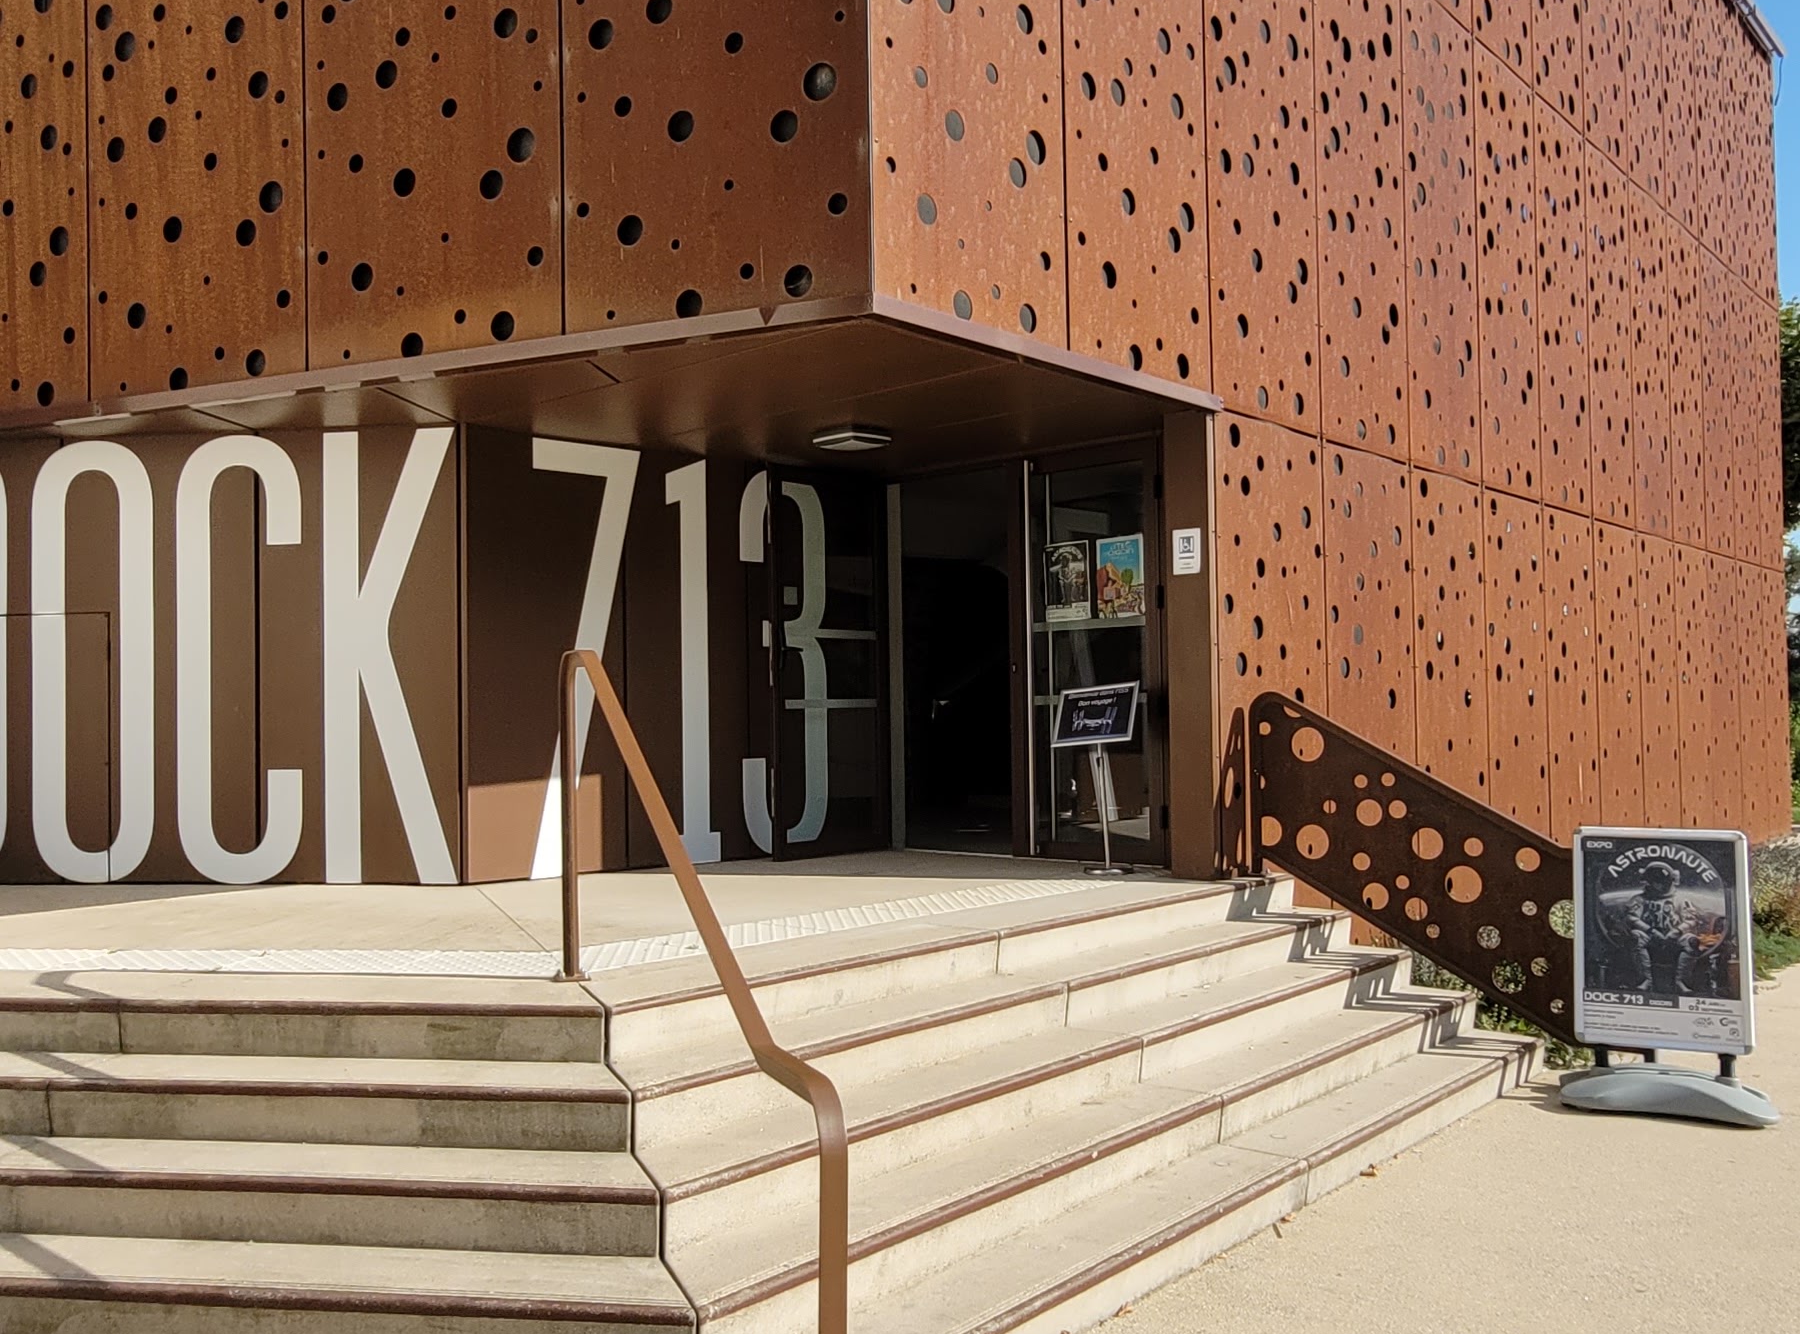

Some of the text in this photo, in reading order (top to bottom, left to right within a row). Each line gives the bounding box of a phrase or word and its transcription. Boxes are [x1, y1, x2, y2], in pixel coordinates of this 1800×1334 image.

[0, 427, 828, 884] OCK 713
[1586, 841, 1613, 849] EXPO
[1607, 845, 1718, 883] ASTRONAUTE
[1584, 991, 1620, 1003] DOCK
[1622, 993, 1644, 1005] 713
